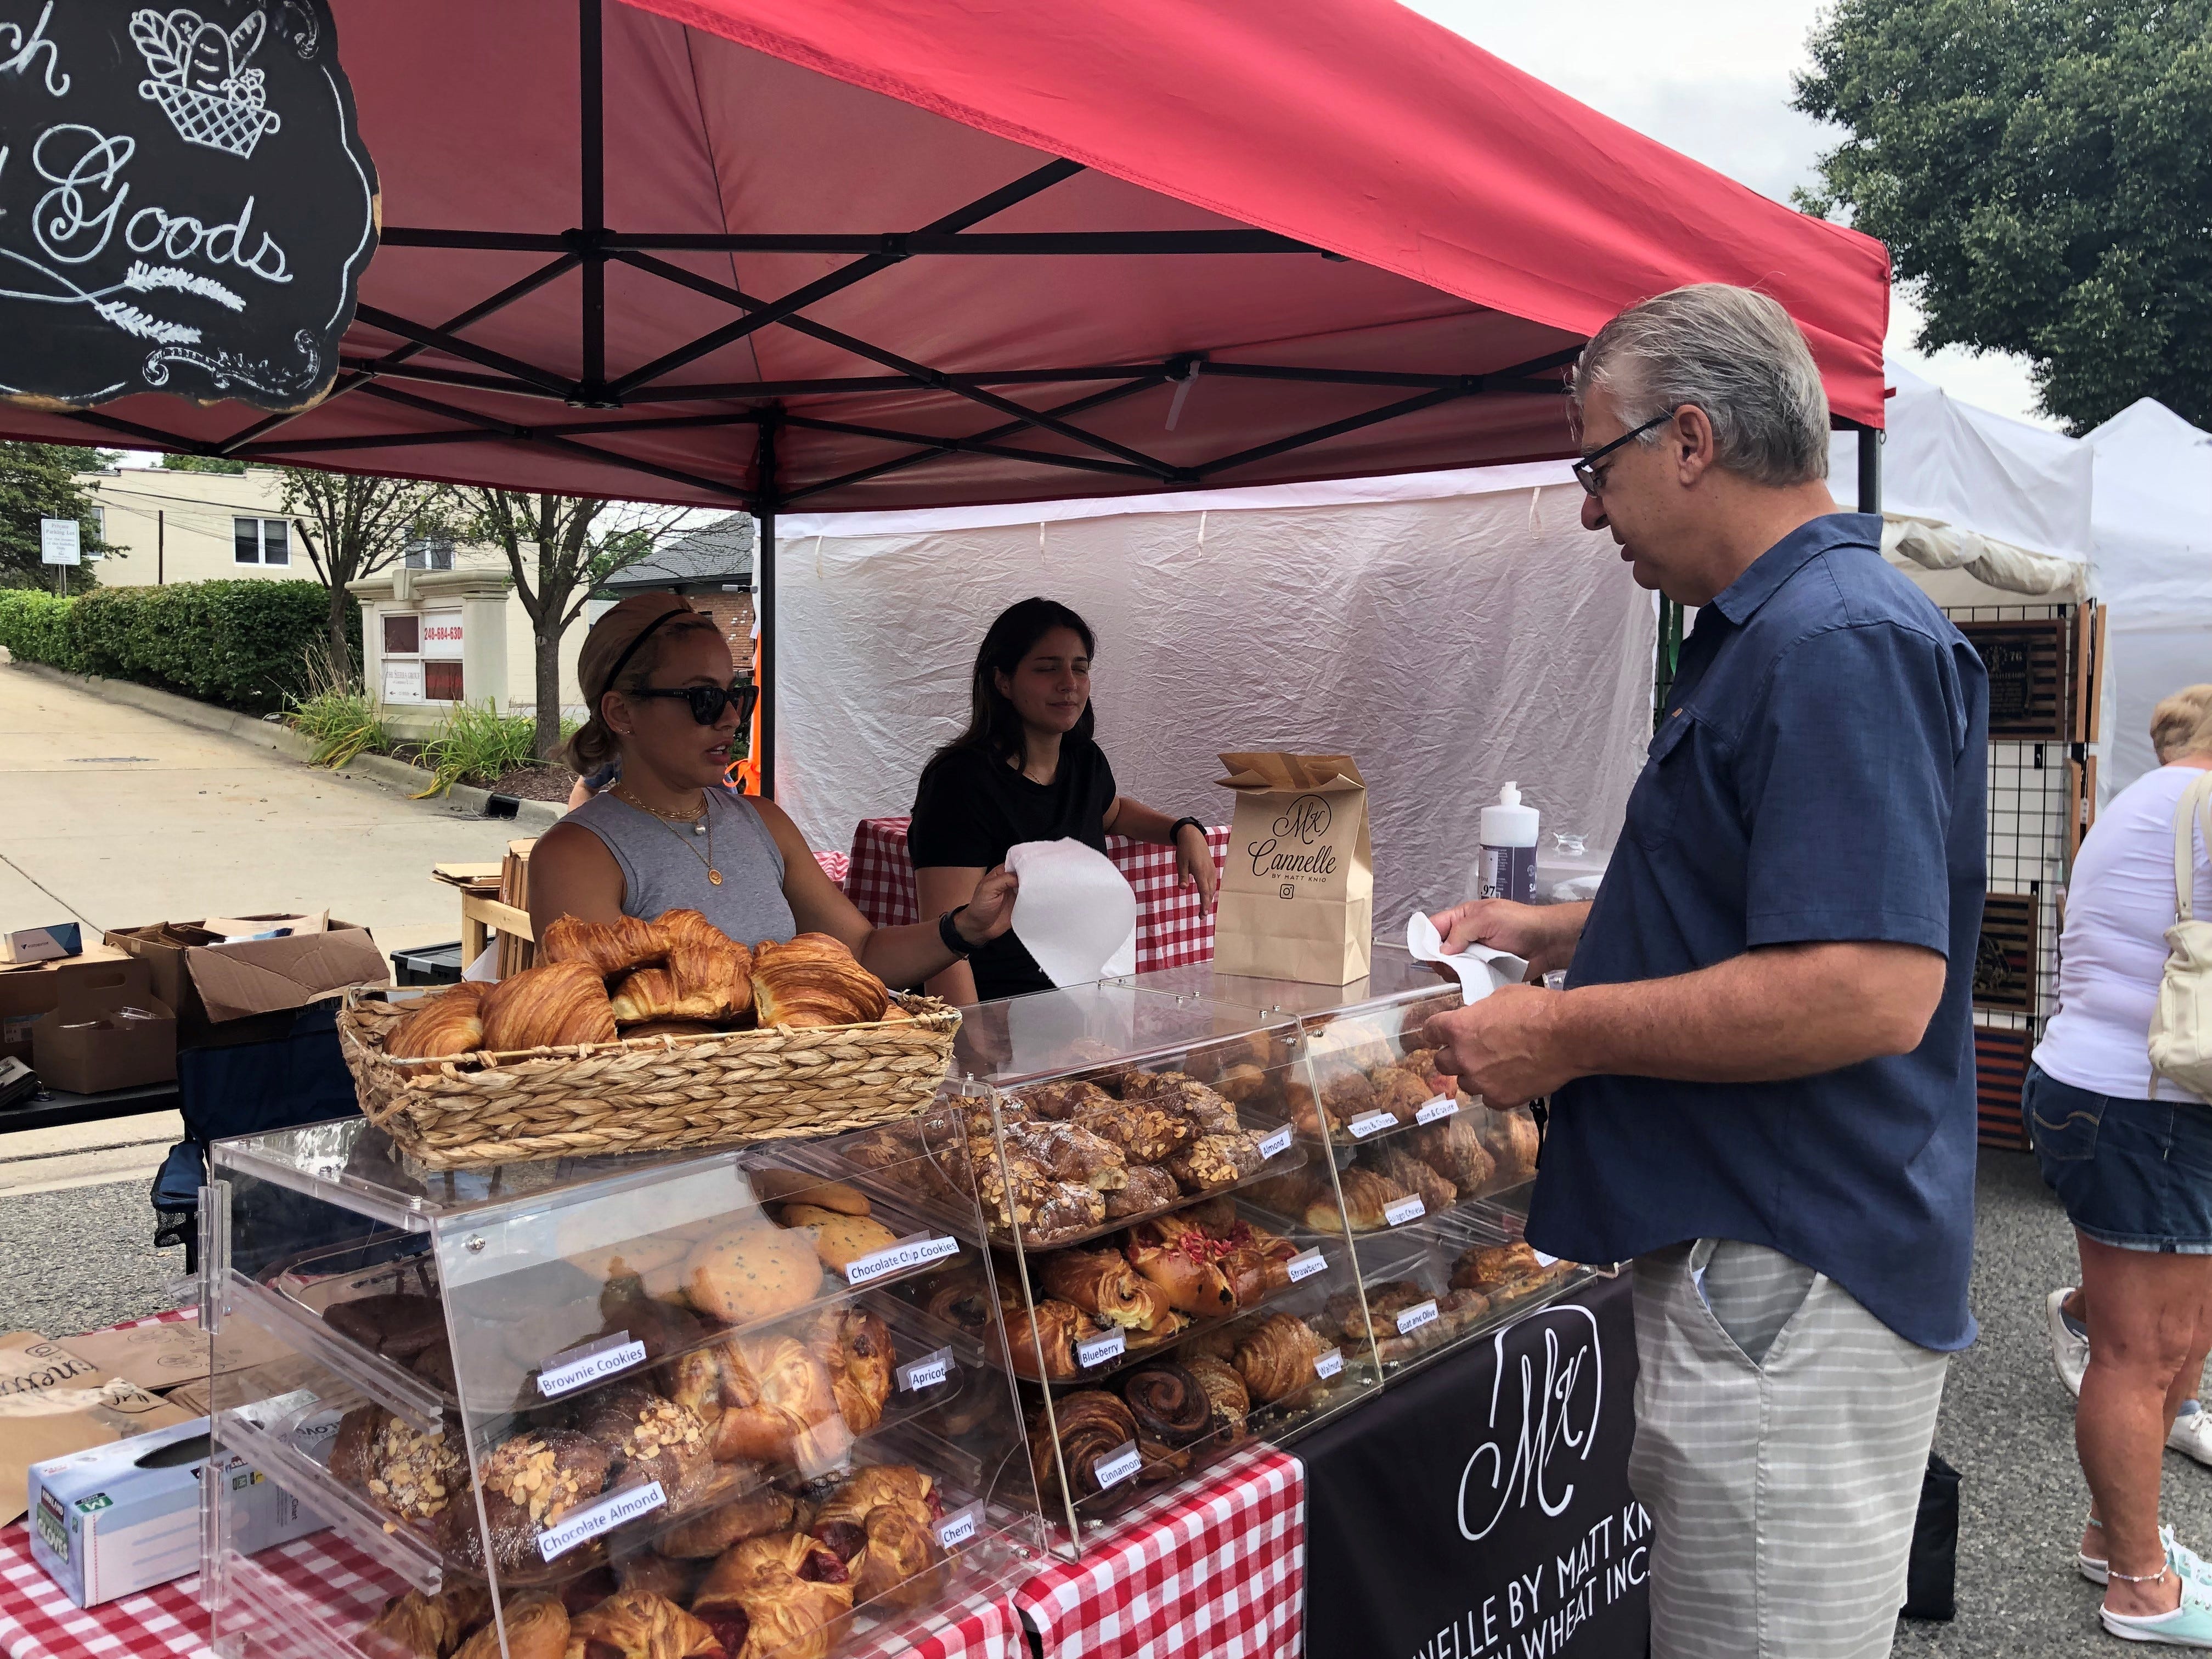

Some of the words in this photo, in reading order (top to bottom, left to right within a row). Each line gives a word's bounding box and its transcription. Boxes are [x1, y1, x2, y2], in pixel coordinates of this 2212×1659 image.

[33, 123, 294, 283] Goods
[1248, 839, 1337, 876] Cannelle
[1430, 1109, 1436, 1118] &
[1263, 1137, 1284, 1155] Almond
[1405, 1206, 1424, 1217] Cheese
[851, 1256, 899, 1278] Chocolate
[900, 1249, 919, 1262] Chip
[921, 1242, 957, 1257] Cookies
[1290, 1261, 1324, 1279] Strawberry
[1399, 1319, 1412, 1331] Goat
[1422, 1309, 1436, 1320] Olive
[1082, 1344, 1118, 1363] Blueberry
[542, 1365, 594, 1391] Brownie
[597, 1348, 643, 1372] Cookies
[913, 1367, 946, 1385] Apricot
[1319, 1360, 1340, 1375] Walnut
[1101, 1458, 1140, 1483] Cinnamon
[543, 1515, 607, 1553] Chocolate
[610, 1488, 659, 1522] Almond
[944, 1521, 972, 1543] Cherry
[1508, 1564, 1543, 1628] BY
[1556, 1514, 1613, 1599] MATT
[1521, 1576, 1596, 1659] WHEAT
[1606, 1546, 1651, 1605] INC.
